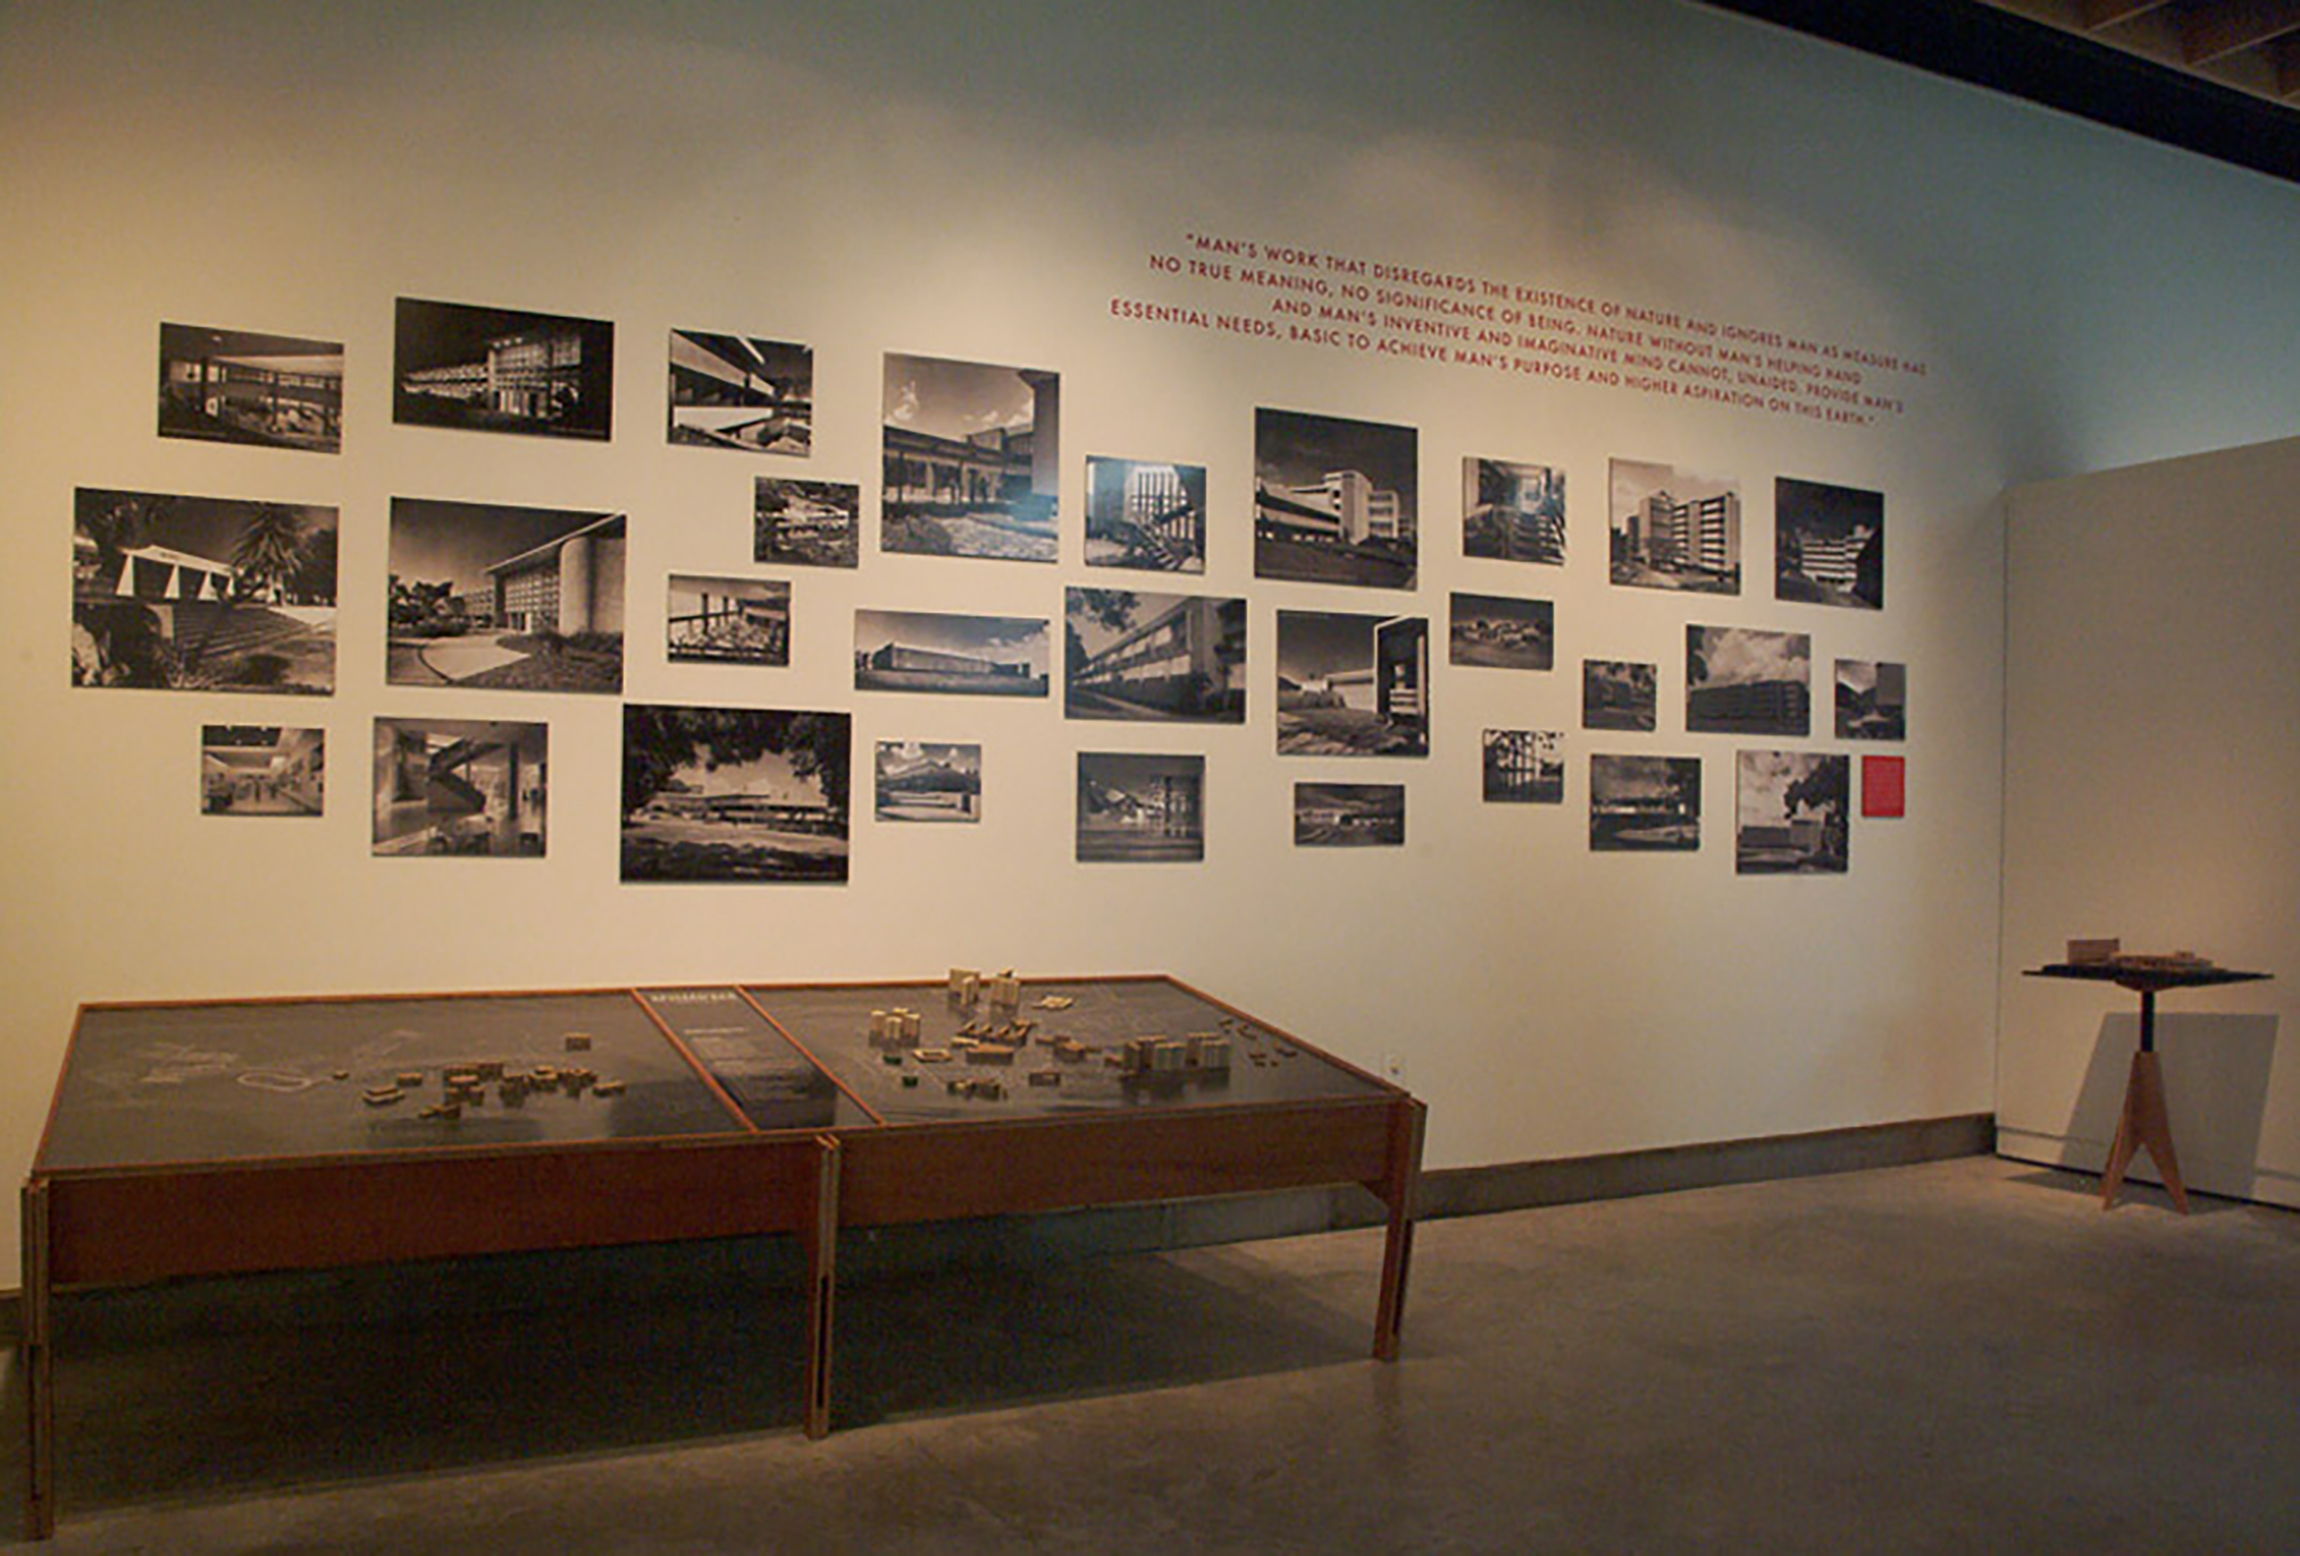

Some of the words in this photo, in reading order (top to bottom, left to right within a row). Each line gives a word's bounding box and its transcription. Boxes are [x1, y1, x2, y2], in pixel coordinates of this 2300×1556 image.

[1110, 299, 1209, 328] ESSENTIAL
[1217, 315, 1281, 339] NEEDS,
[1290, 326, 1341, 346] BASIC
[1348, 333, 1369, 350] TO
[1377, 338, 1447, 362] ACHIEVE
[1513, 358, 1580, 381] PURPOSE
[1587, 370, 1619, 386] AND
[1625, 376, 1678, 395] HIGHER
[1684, 385, 1764, 408] ASPIRATION
[1769, 398, 1790, 413] ON
[1796, 402, 1821, 419] THIS
[1150, 255, 1181, 272] NO
[1189, 260, 1232, 281] TRUE
[1241, 270, 1333, 298] MEANING,
[1342, 285, 1369, 301] NO
[1377, 289, 1494, 321] SIGNIFICANCE
[1501, 309, 1522, 324] OF
[1588, 324, 1643, 346] NATURE
[1649, 336, 1712, 356] WITHOUT
[1767, 357, 1820, 378] HELPING
[1825, 368, 1861, 385] HAND
[1264, 245, 1319, 269] WORK
[1326, 256, 1366, 276] THAT
[1373, 264, 1476, 294] DISREGARDS
[1482, 281, 1508, 298] THE
[1515, 286, 1595, 315] EXISTENCE
[1601, 302, 1620, 317] OF
[1626, 307, 1681, 329] NATURE
[1686, 319, 1717, 336] AND
[1721, 325, 1782, 347] IGNORES
[1787, 339, 1818, 354] MAN
[1823, 346, 1838, 358] AS
[1272, 299, 1312, 316] AND
[1384, 315, 1470, 341] INVENTIVE
[1478, 329, 1512, 347] AND
[1518, 336, 1617, 363] IMAGINATIVE
[1625, 353, 1662, 370] MIND
[1806, 383, 1858, 404] PROVIDE
